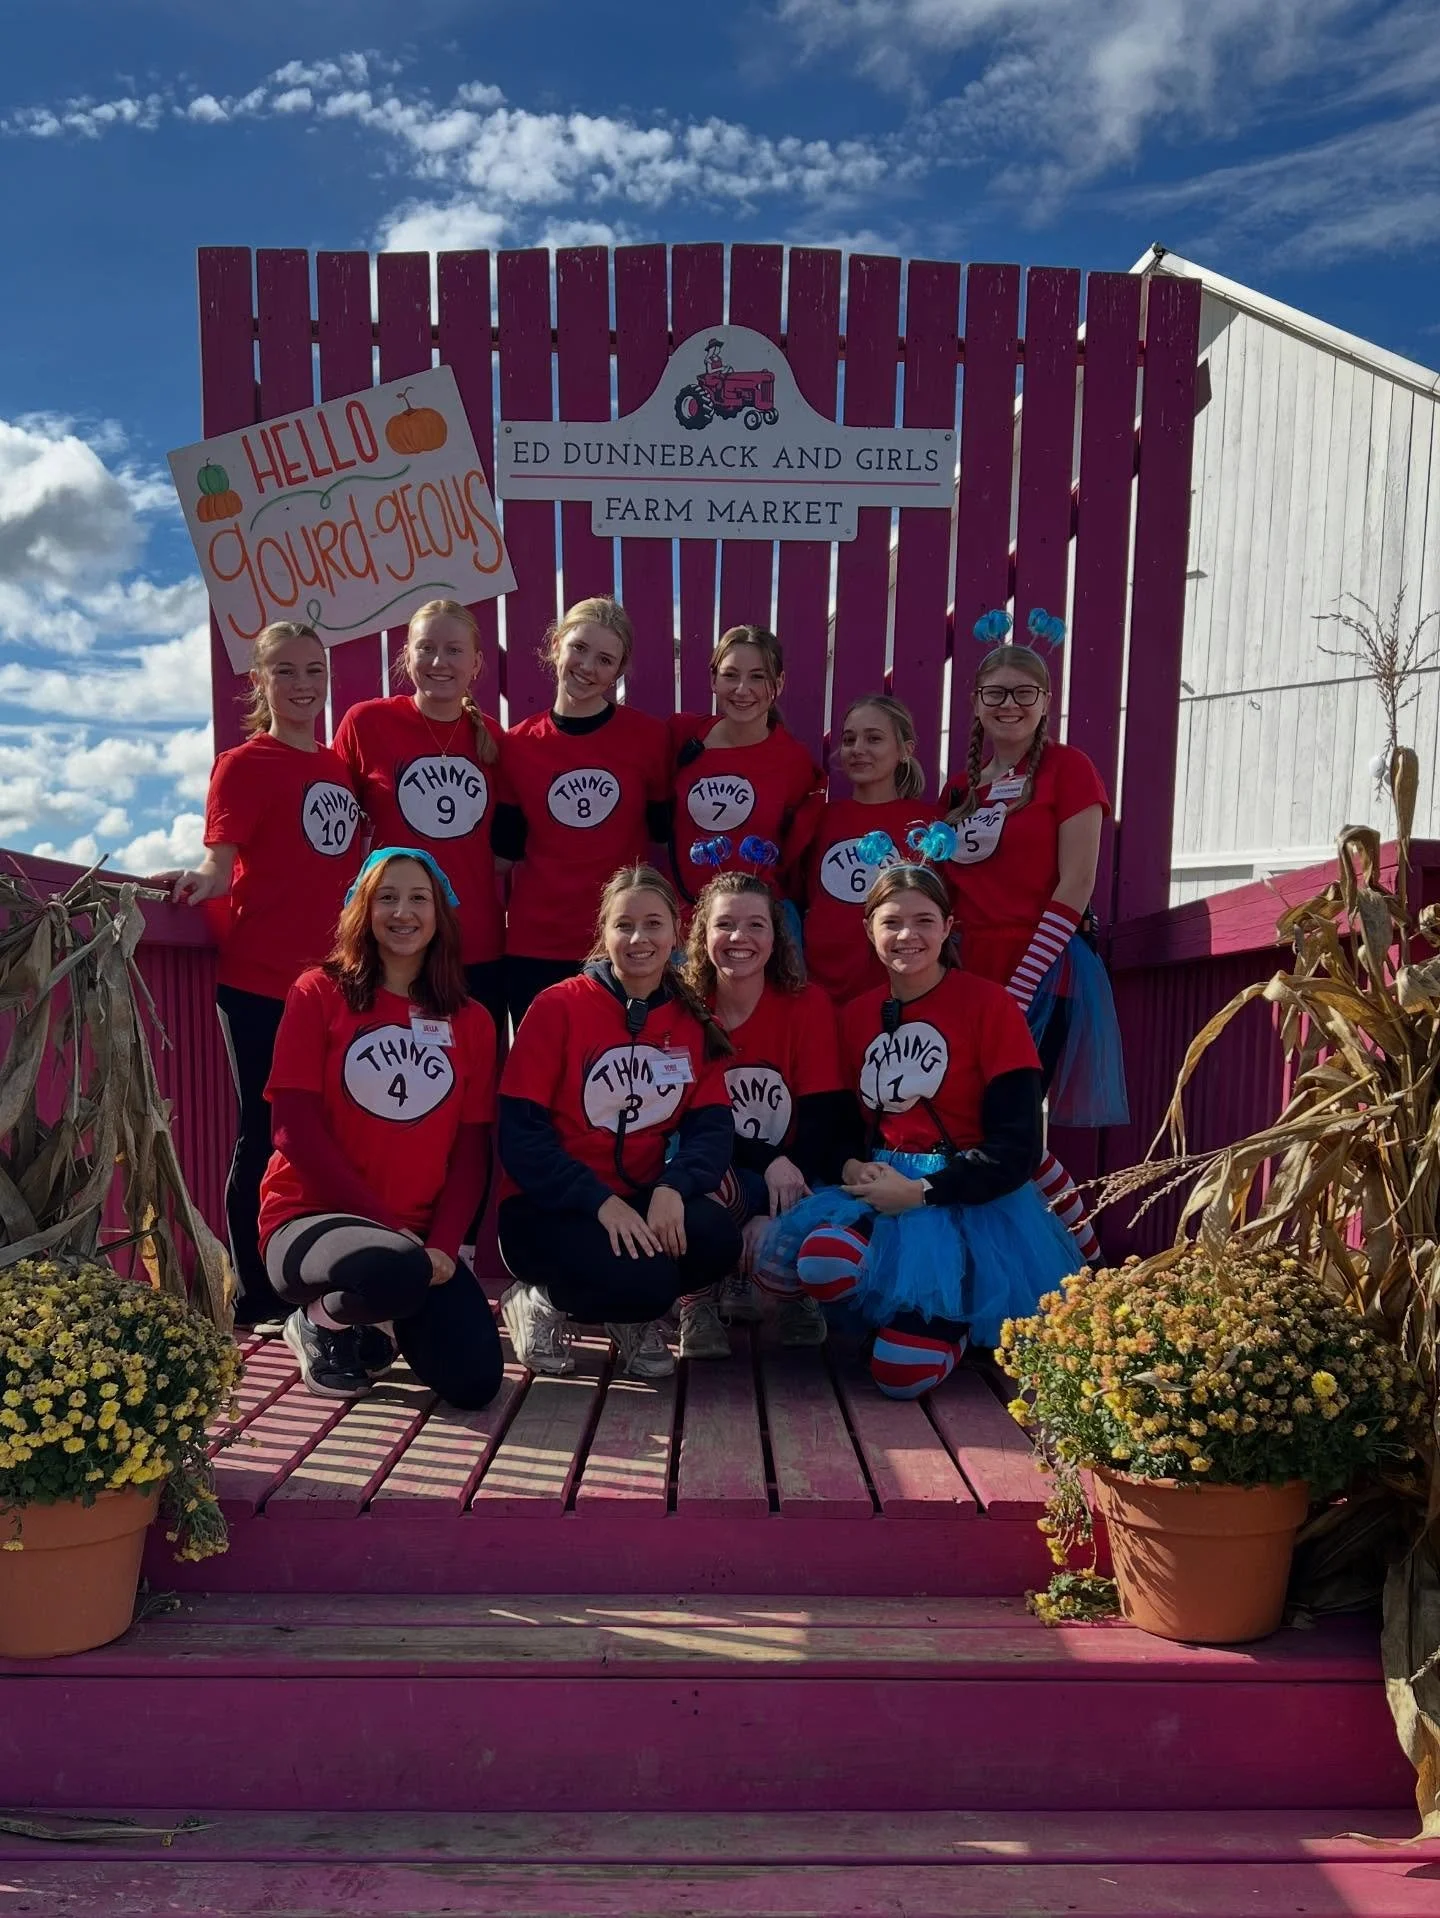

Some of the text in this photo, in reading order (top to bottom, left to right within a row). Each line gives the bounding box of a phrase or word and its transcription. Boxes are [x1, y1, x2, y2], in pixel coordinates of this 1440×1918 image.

[242, 400, 380, 494] HELLO
[513, 442, 939, 472] ED DUNNEBACK AND GIRLS
[605, 497, 843, 525] FARM MARKET
[404, 764, 483, 800] THING
[555, 775, 614, 801] THING
[691, 781, 750, 805] THING
[309, 790, 359, 822] THING
[436, 795, 456, 824] 9
[577, 797, 591, 819] 8
[712, 801, 728, 821] 7
[322, 819, 346, 846] 10
[965, 830, 980, 852] 5
[850, 868, 866, 893] 6
[357, 1038, 446, 1080] THING
[868, 1034, 942, 1074] THING
[387, 1072, 409, 1107] 4
[730, 1076, 783, 1113] HING
[887, 1074, 907, 1103] 1
[624, 1093, 644, 1123] 3
[743, 1117, 770, 1142] 2
